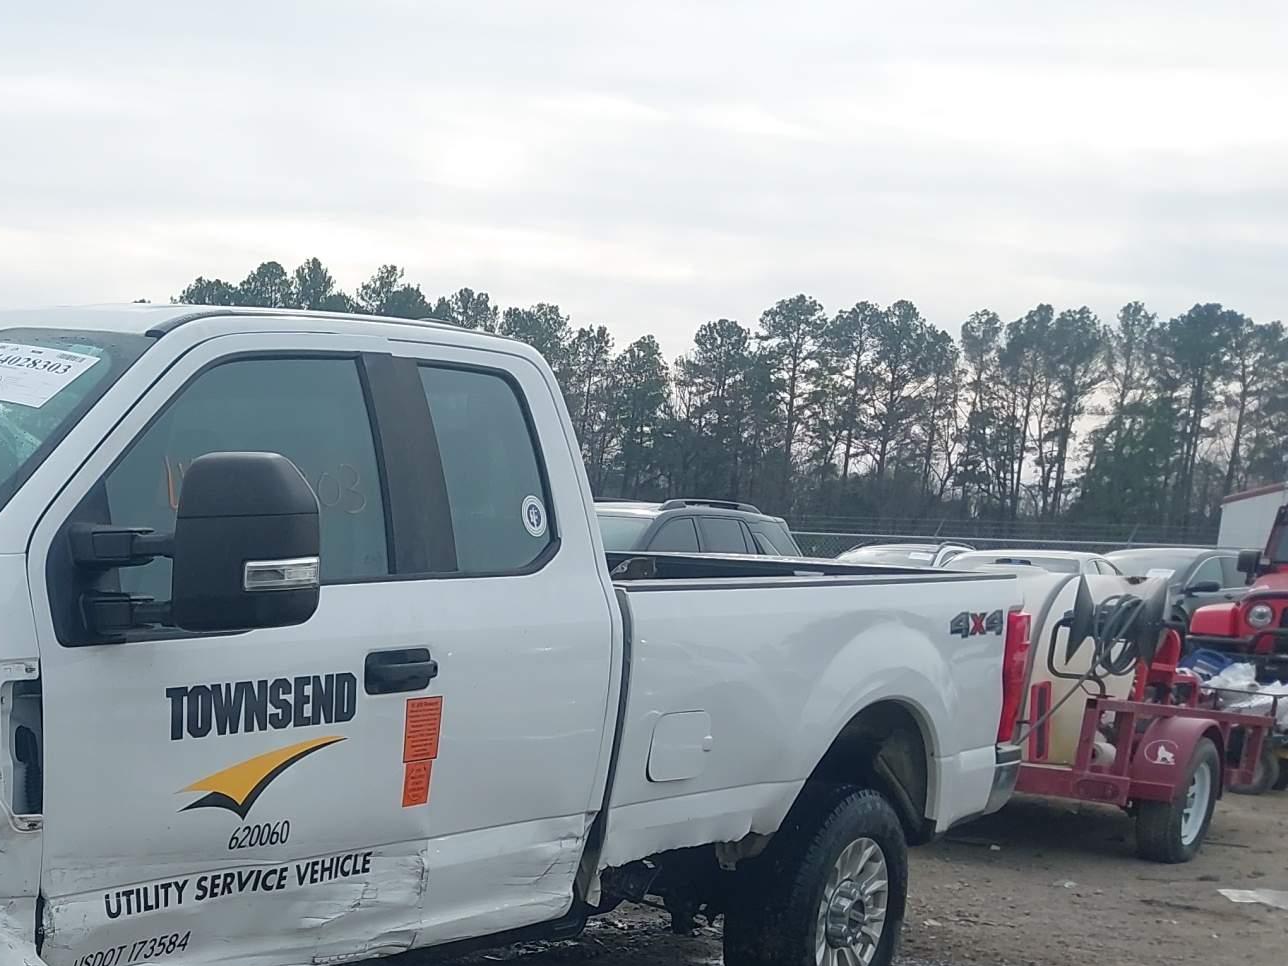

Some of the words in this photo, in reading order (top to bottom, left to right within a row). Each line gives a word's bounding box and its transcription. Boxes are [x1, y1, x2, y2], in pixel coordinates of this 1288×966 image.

[165, 671, 358, 741] TOWNSEND
[228, 820, 291, 850] 620060
[105, 879, 189, 919] UTILITY
[194, 865, 289, 902] SERVICE
[296, 850, 374, 887] VEHICLE
[127, 930, 191, 962] 173584
